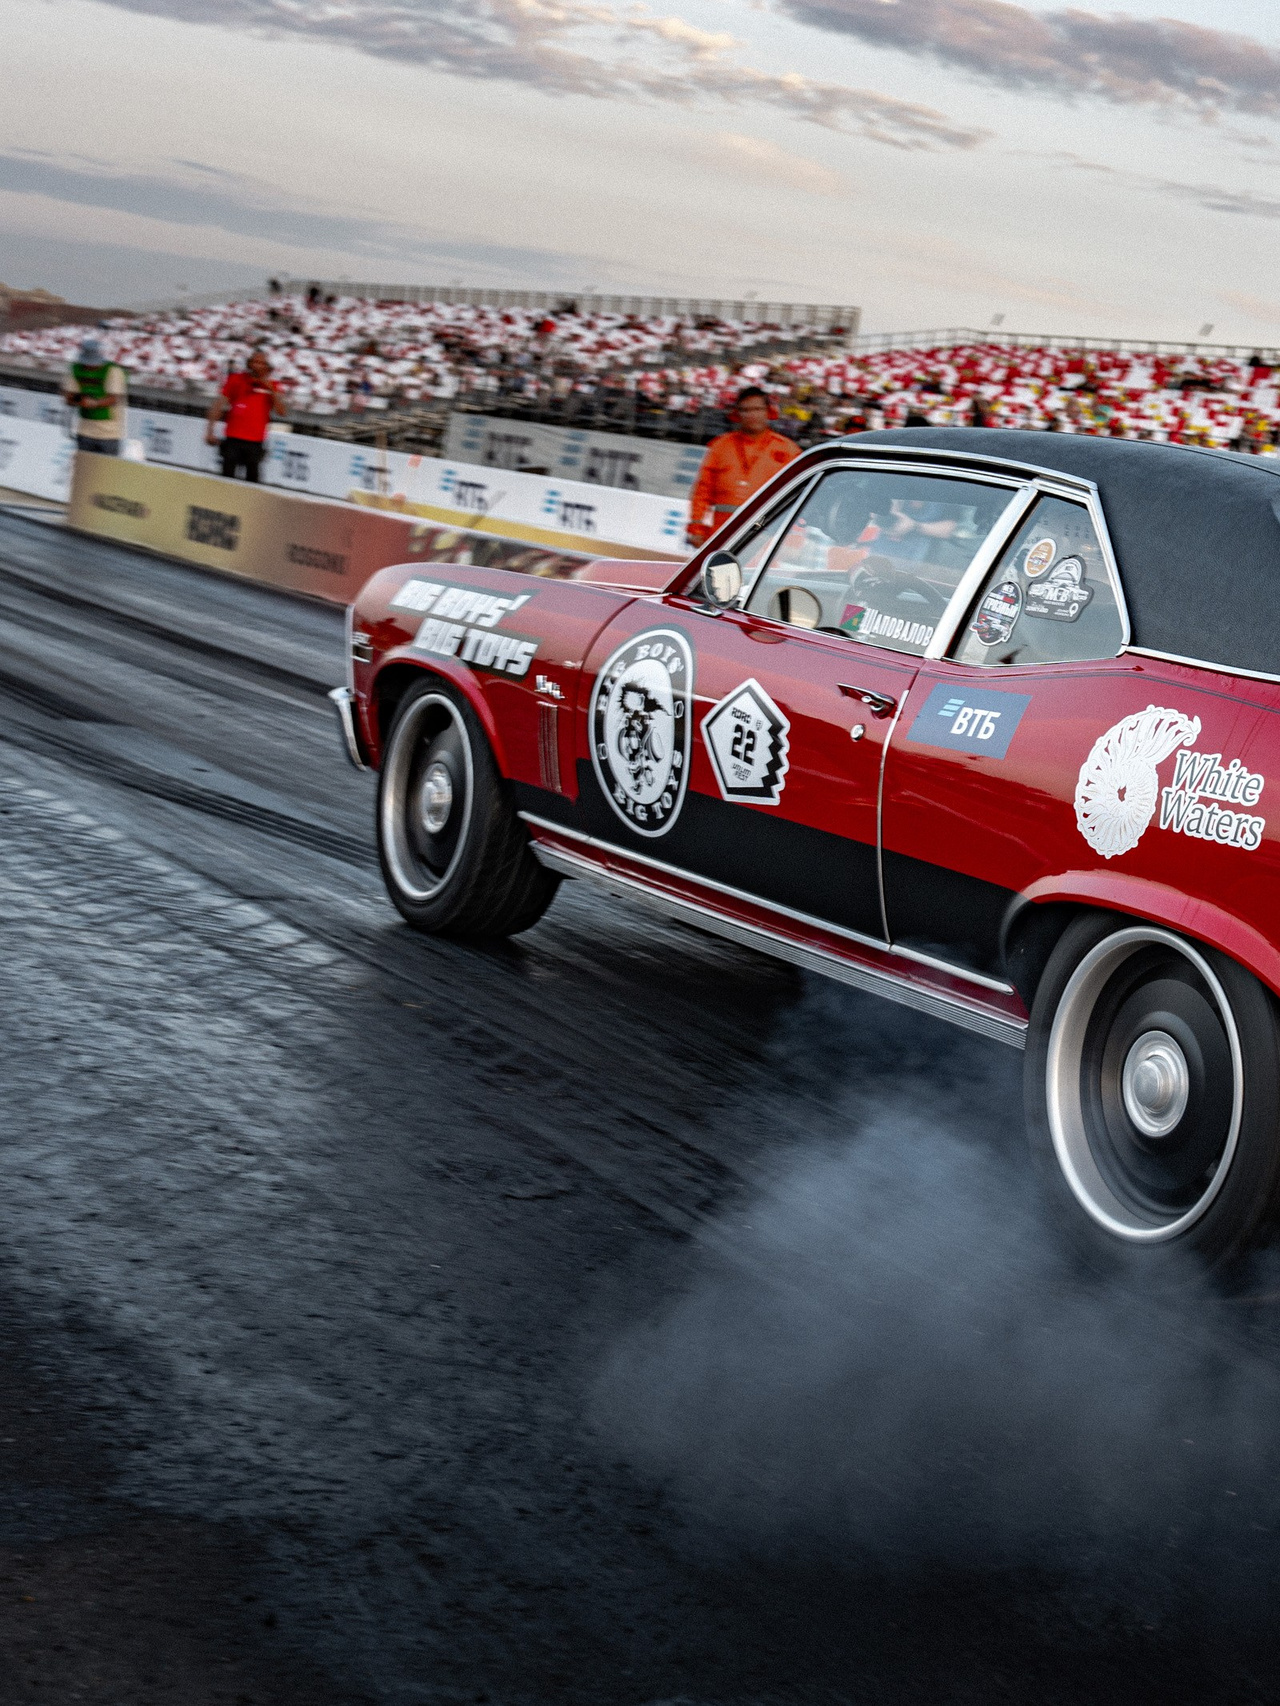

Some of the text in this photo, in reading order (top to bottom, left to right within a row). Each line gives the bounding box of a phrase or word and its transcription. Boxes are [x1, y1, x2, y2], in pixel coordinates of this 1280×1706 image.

[391, 580, 446, 611] BIG
[413, 618, 539, 676] BIG TOYS
[858, 607, 934, 647] ШАПОВАЛОВ
[731, 723, 756, 766] 22
[950, 707, 1002, 740] ВТБ
[1174, 752, 1262, 803] White
[1162, 790, 1262, 847] Waters
